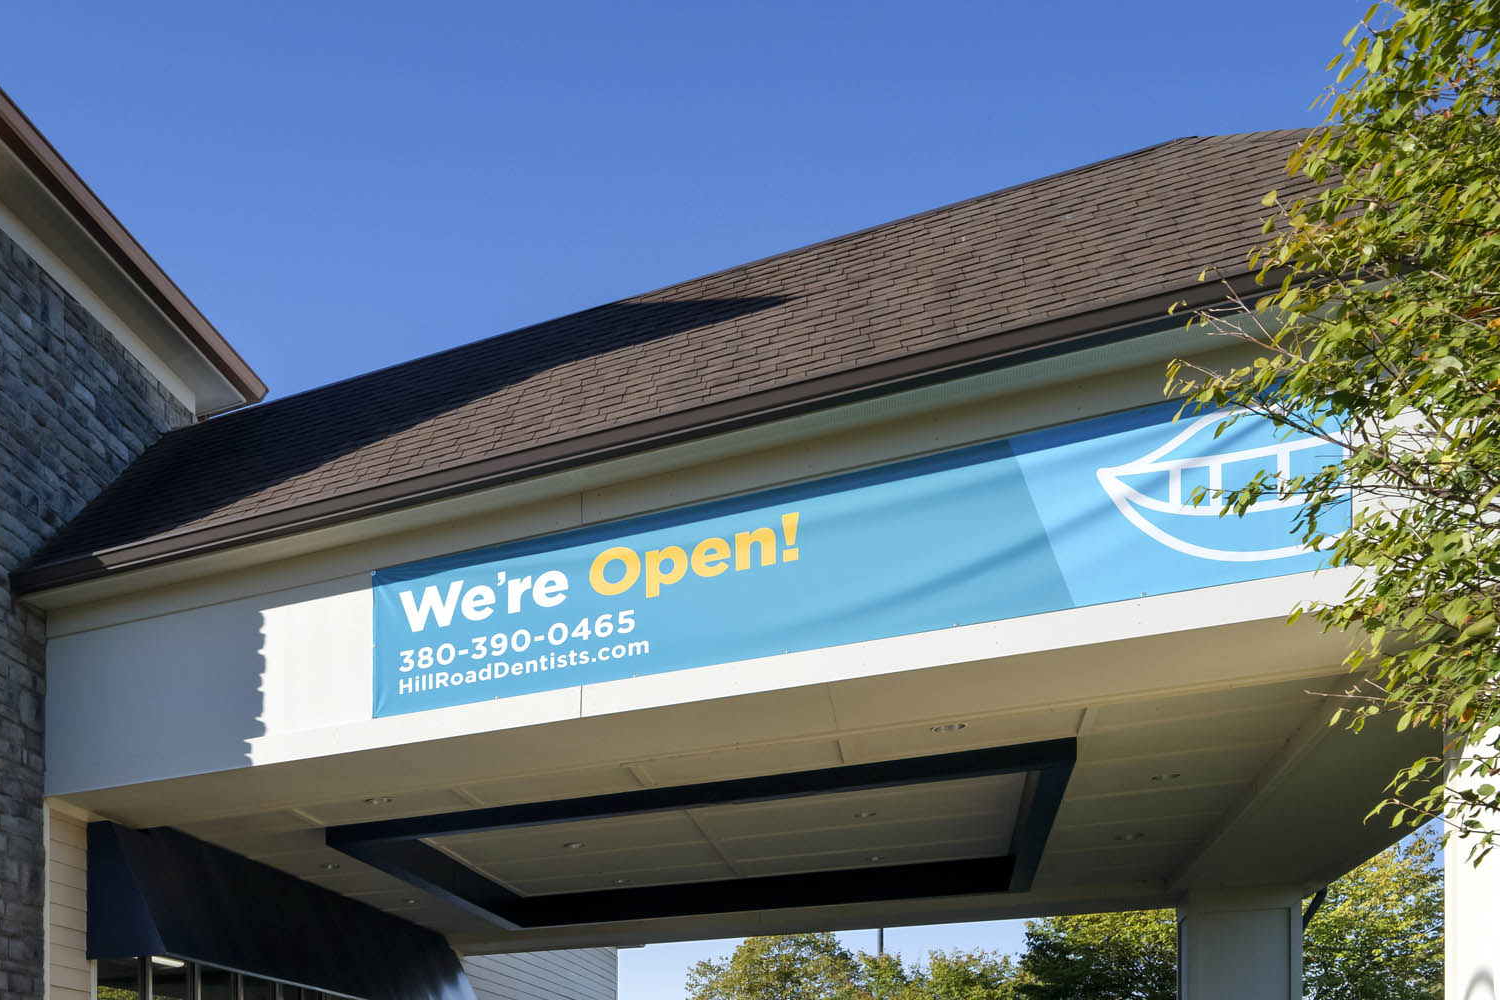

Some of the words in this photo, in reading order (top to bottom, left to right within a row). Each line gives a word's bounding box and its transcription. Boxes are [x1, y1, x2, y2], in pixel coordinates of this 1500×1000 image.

[399, 569, 569, 633] We're
[588, 511, 800, 598] Open!
[398, 639, 651, 695] HillRoadDentists.com
[399, 609, 636, 673] 380-390-0465
